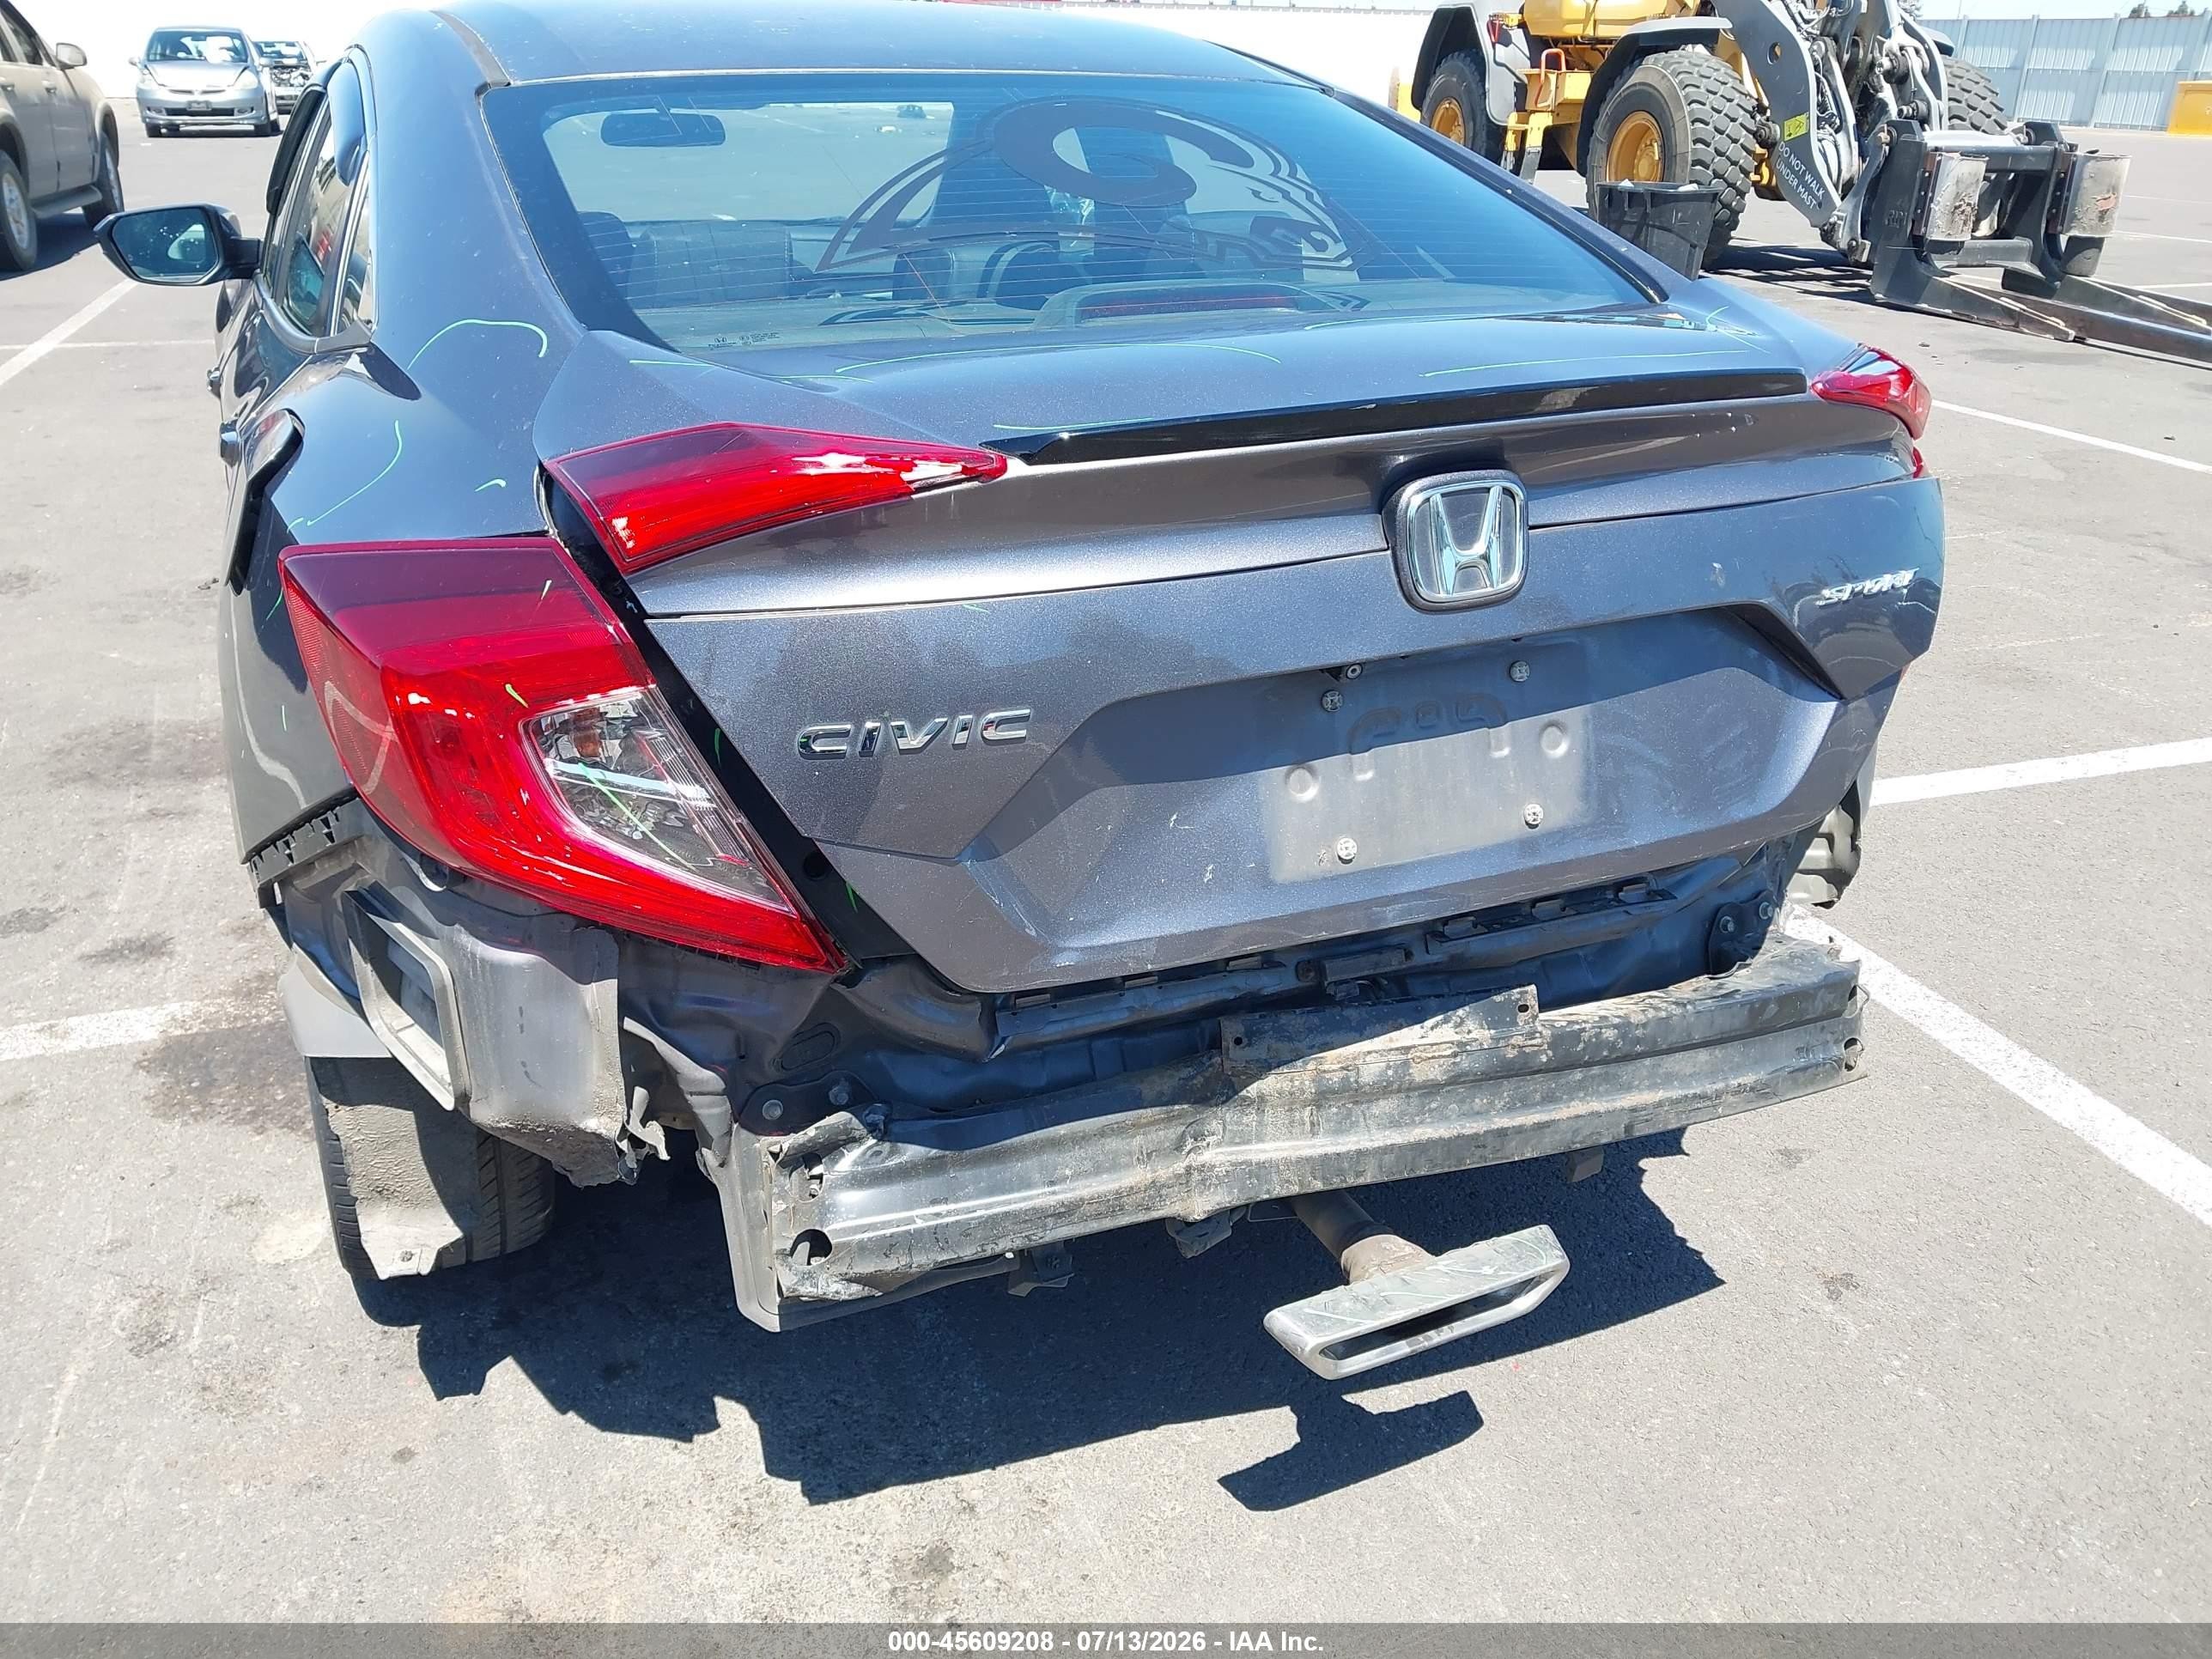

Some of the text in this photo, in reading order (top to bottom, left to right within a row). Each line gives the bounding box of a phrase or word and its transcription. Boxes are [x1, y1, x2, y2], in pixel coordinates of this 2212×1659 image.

[1776, 159, 1817, 209] UNDER MAST
[1778, 141, 1826, 199] DO NOT WALK
[797, 708, 1031, 759] CIVIC
